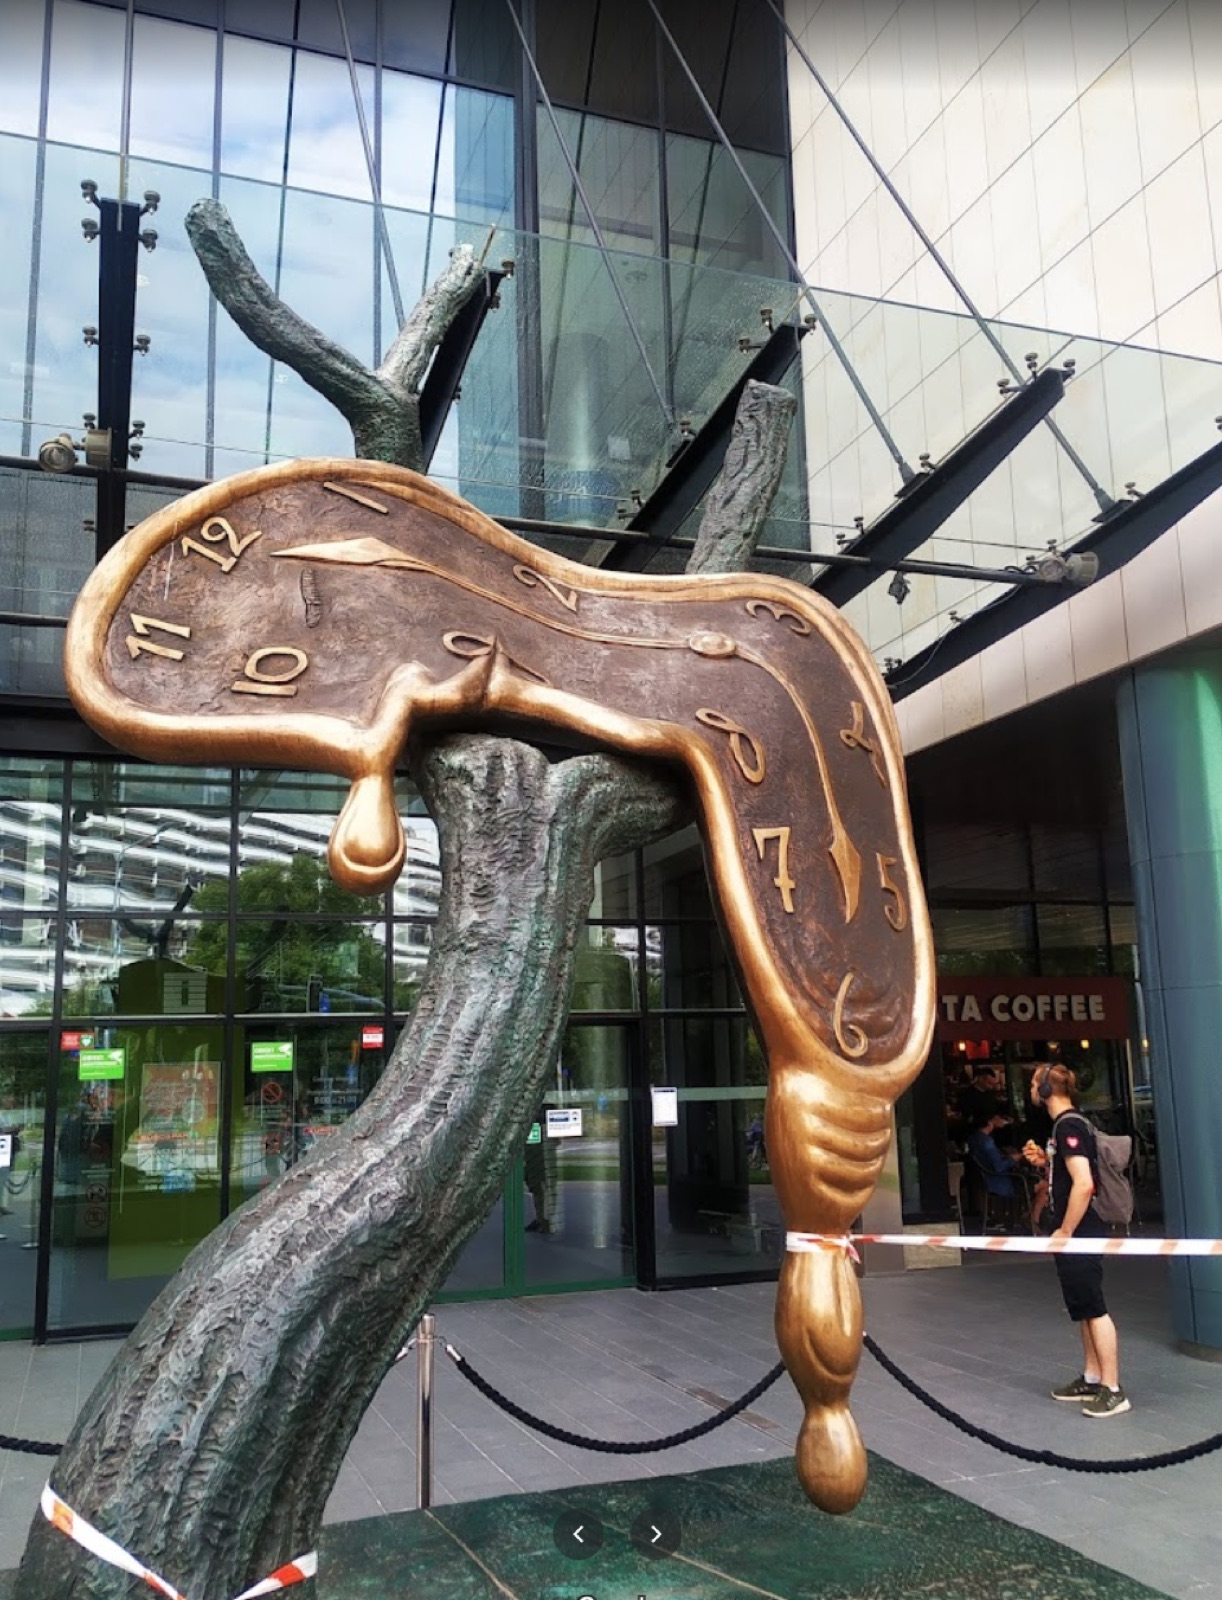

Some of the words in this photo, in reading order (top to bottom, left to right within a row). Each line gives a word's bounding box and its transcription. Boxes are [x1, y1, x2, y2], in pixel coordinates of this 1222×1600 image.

[180, 516, 262, 573] 12
[513, 564, 577, 611] 2
[125, 613, 191, 661] 11
[746, 600, 811, 635] 3
[231, 646, 308, 697] 10
[696, 707, 766, 784] 8
[752, 826, 797, 914] 7
[876, 852, 906, 932] 5
[833, 972, 868, 1058] 6
[991, 995, 1106, 1021] COFFEE
